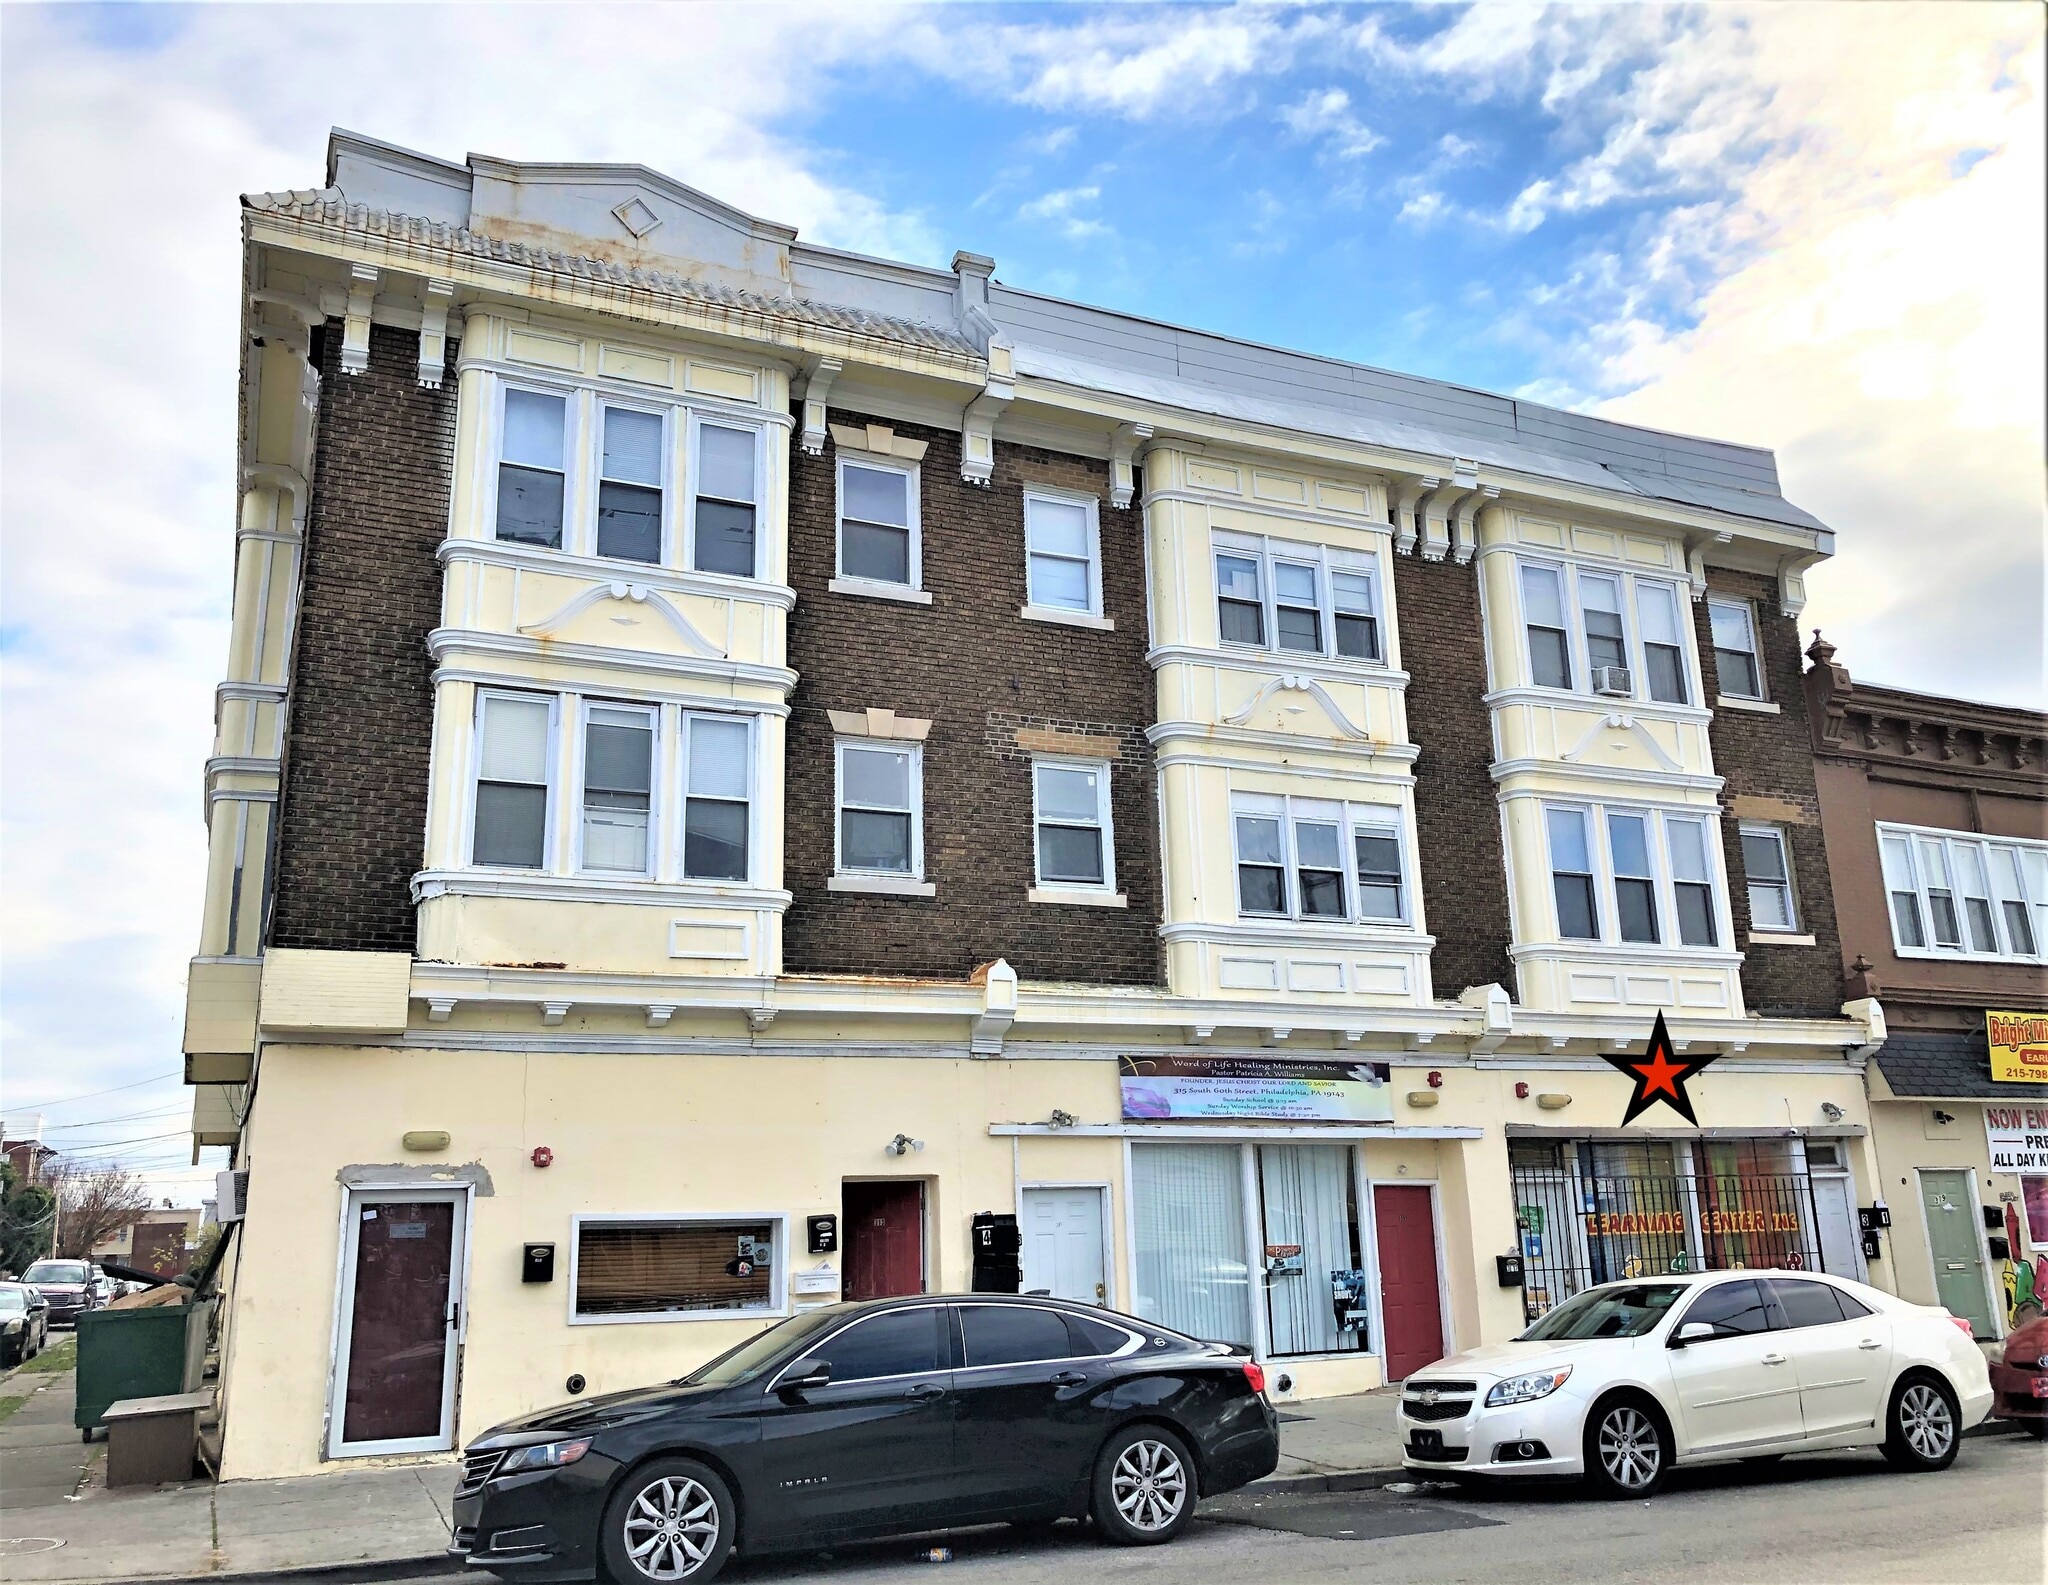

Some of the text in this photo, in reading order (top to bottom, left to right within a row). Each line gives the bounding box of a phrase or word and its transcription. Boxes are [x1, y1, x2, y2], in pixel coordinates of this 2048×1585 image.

[1990, 1017, 2030, 1051] Bright
[1202, 1060, 1212, 1069] of
[1214, 1061, 1232, 1069] Life
[1234, 1061, 1270, 1070] Healing
[1273, 1063, 1321, 1071] Ministries,
[2026, 1054, 2048, 1063] EARL
[1987, 1108, 2048, 1129] NOW EN
[1993, 1153, 2014, 1167] ALL
[2017, 1153, 2036, 1167] DAY
[1586, 1211, 1685, 1235] LEARNING
[1701, 1210, 1765, 1233] CENTER
[1862, 1214, 1869, 1226] 3
[983, 1230, 991, 1245] 4
[779, 1476, 828, 1488] IMPALA
